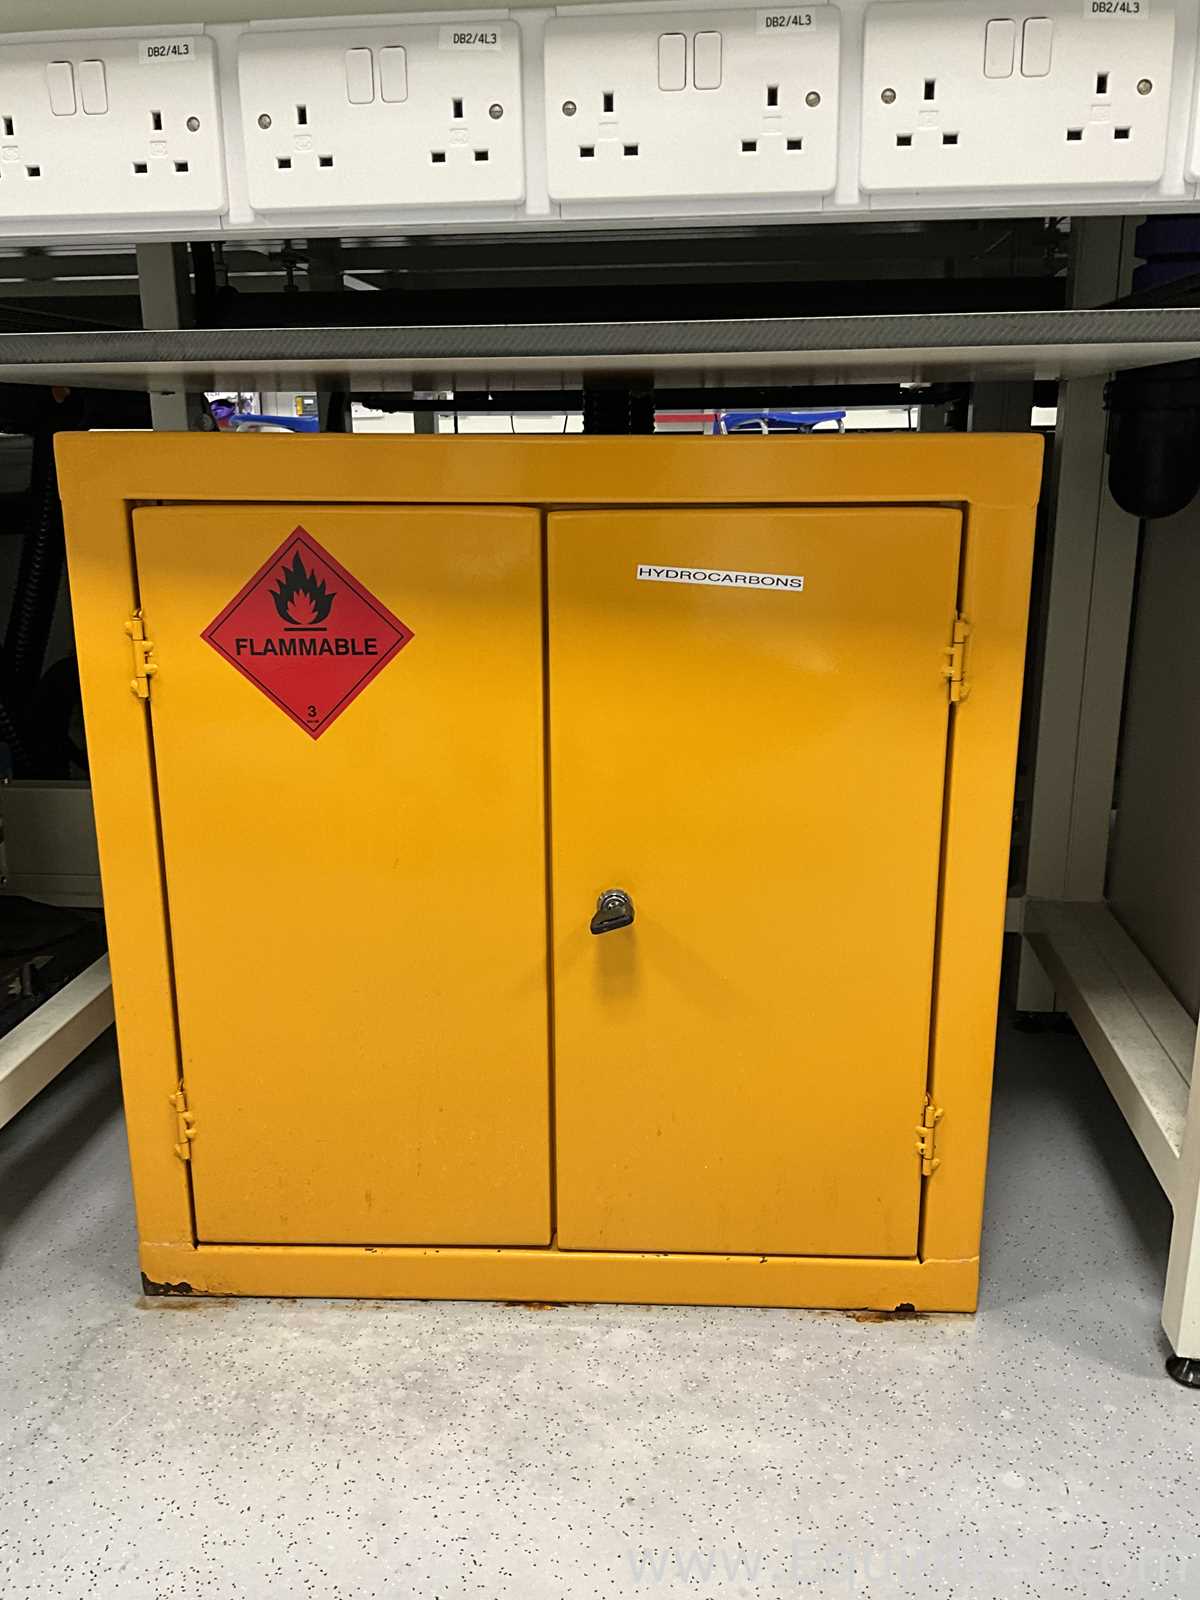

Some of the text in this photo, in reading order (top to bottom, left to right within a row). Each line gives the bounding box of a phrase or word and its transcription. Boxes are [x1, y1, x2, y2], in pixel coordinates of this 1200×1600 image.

[1091, 1, 1140, 13] DB2/4L3
[765, 14, 812, 28] DB2/4L3
[453, 32, 497, 44] DB2/4L3
[147, 44, 189, 57] DB2/4L3
[639, 567, 802, 588] HYDROCARBONS
[235, 638, 378, 656] FLAMMABLE
[307, 704, 317, 718] 3
